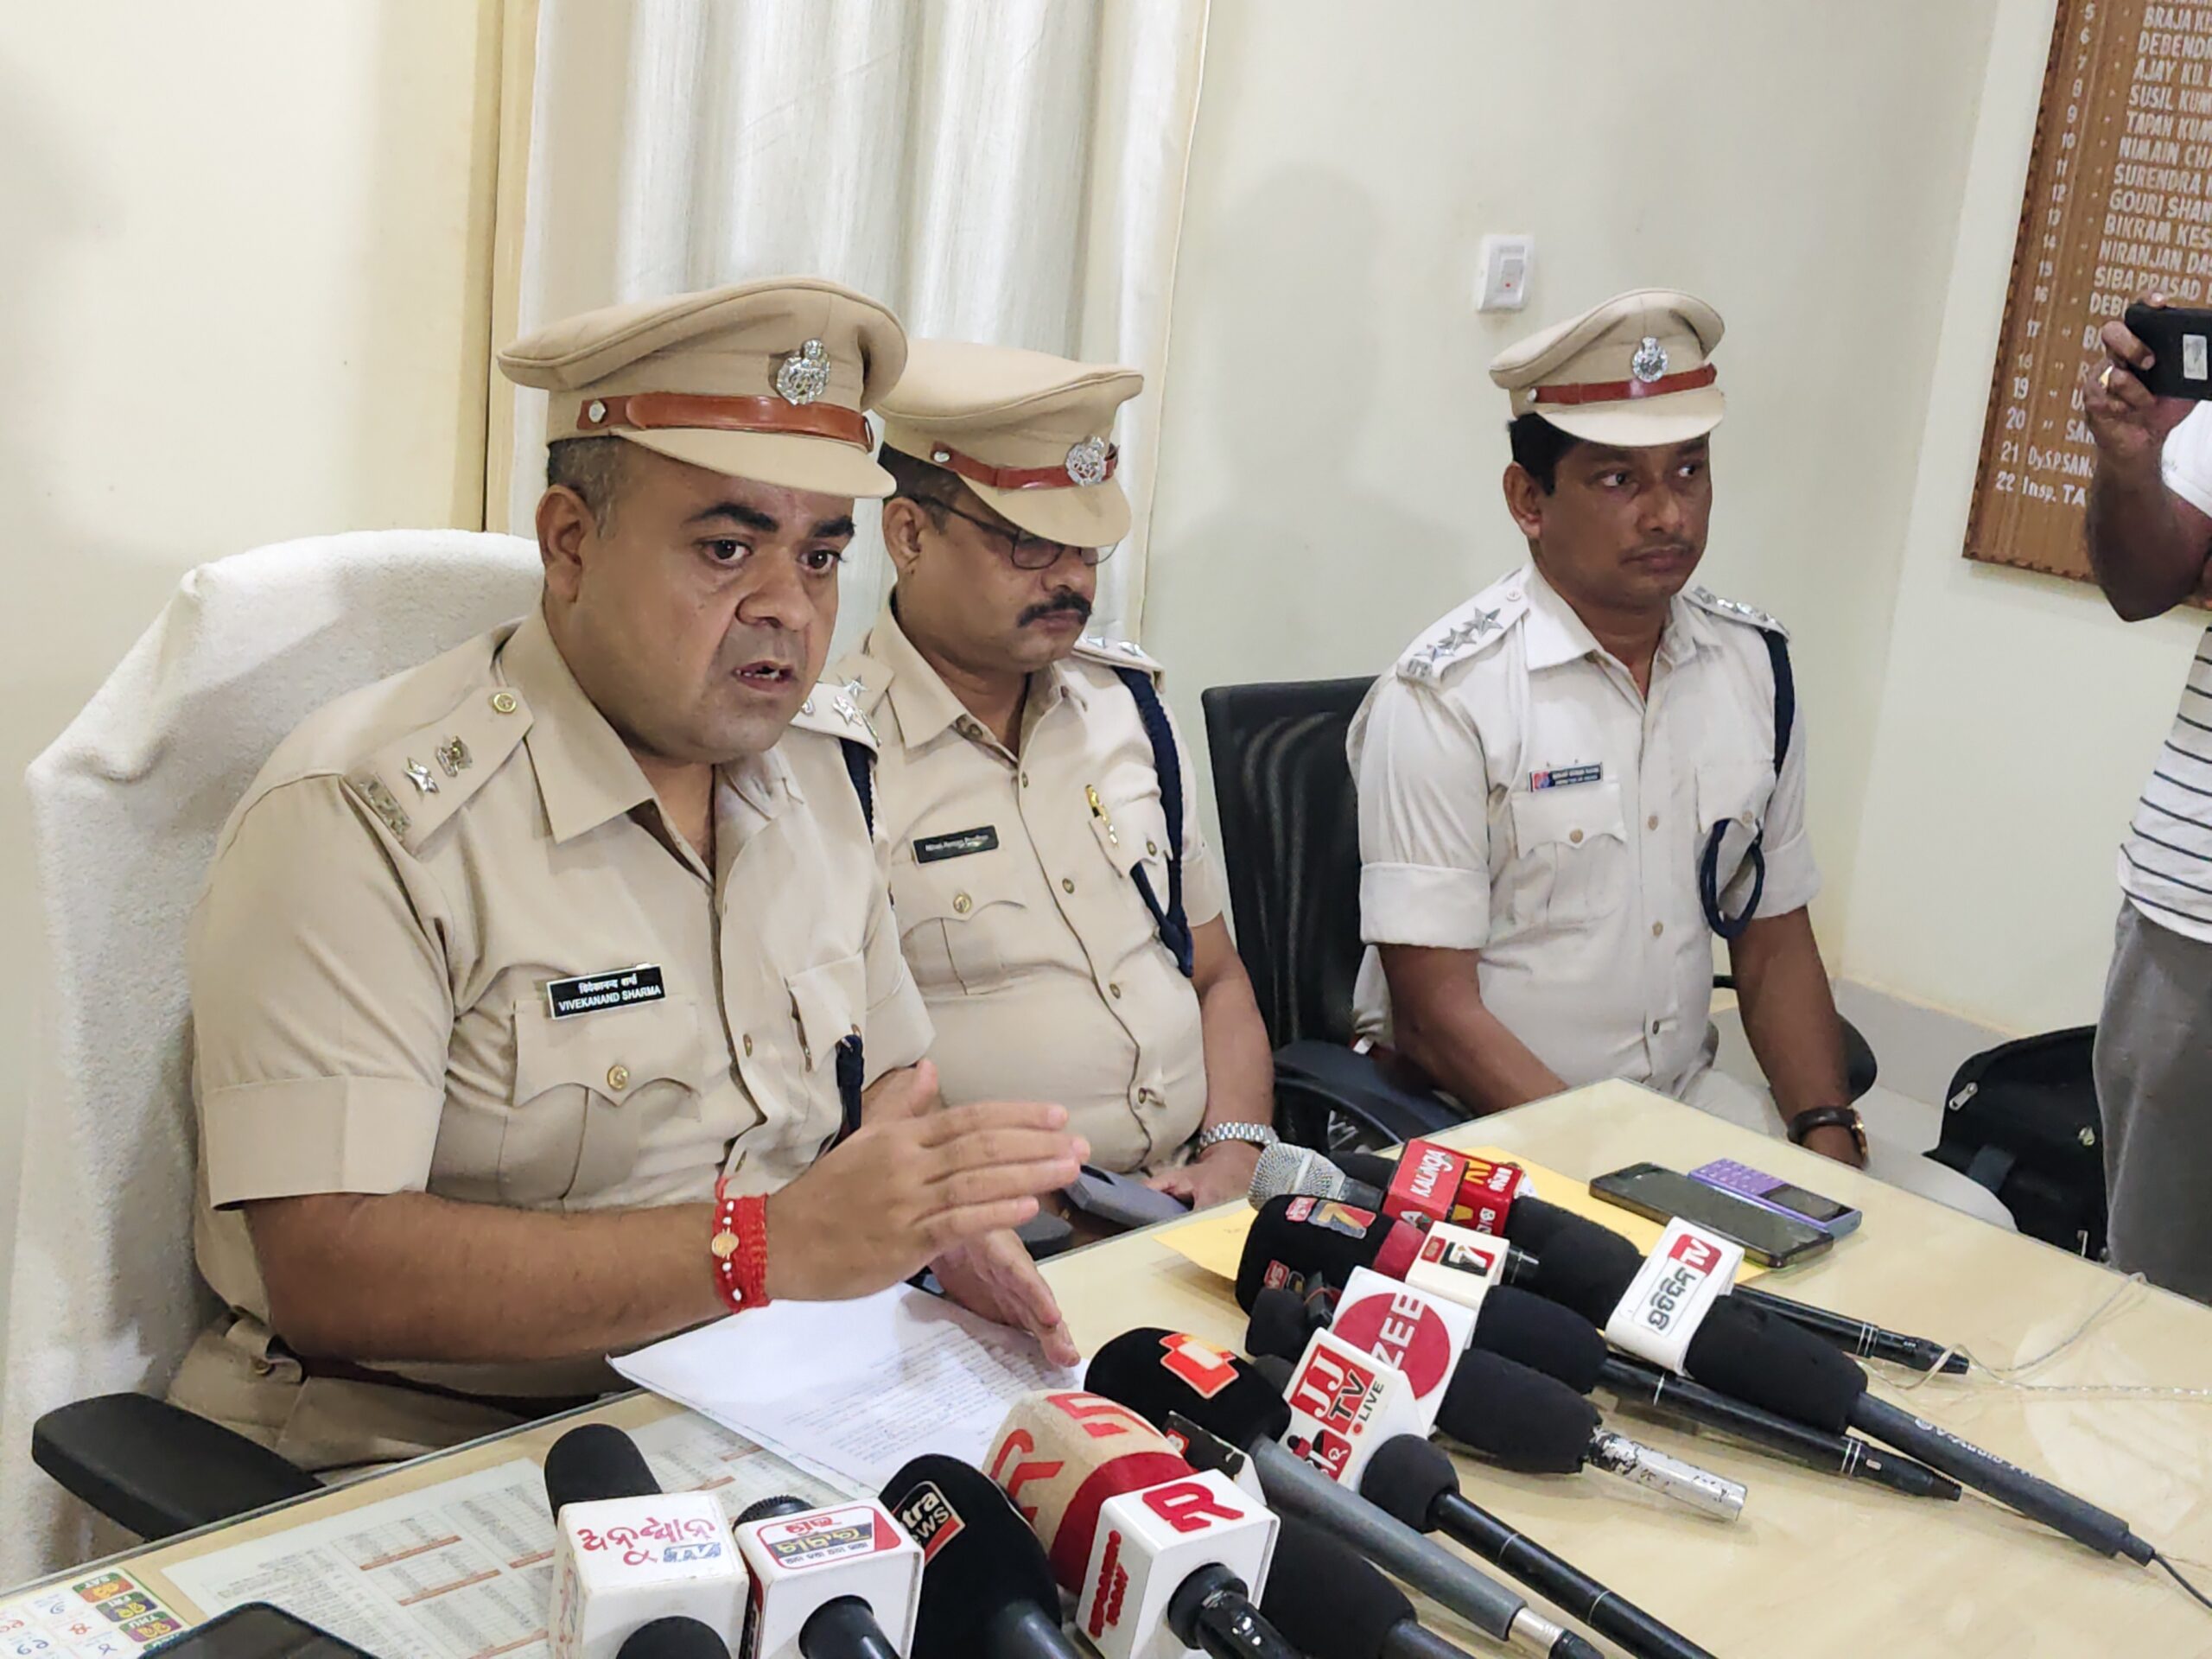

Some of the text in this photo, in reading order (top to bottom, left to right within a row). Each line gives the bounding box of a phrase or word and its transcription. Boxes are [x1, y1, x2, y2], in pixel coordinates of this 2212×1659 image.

[2084, 3, 2095, 20] 5
[2143, 5, 2191, 31] BRAJA
[2080, 26, 2089, 44] 6
[2077, 54, 2088, 71] 7
[2133, 57, 2177, 83] AJAY
[2072, 78, 2083, 98] 8
[2128, 85, 2173, 111] SUSIL
[2066, 105, 2077, 124] 9
[2126, 109, 2173, 137] TAPAN
[2062, 132, 2075, 149] 10
[2113, 162, 2202, 194] SURENDRA
[2052, 183, 2066, 202] 12
[2109, 188, 2164, 218] GOURI
[2103, 213, 2171, 244] BIKRAM
[2098, 238, 2183, 272] NIRANJAN
[2094, 264, 2134, 292] SIBA
[2026, 318, 2042, 339] 17
[2013, 376, 2029, 399] 19
[2005, 405, 2026, 430] 20
[1999, 439, 2019, 465] 21
[1995, 469, 2016, 493] 22
[558, 984, 662, 1012] VIVEKANAND SHARMA
[1679, 1236, 1712, 1267] TV
[1370, 1292, 1426, 1370] ZEE
[1296, 1350, 1344, 1419] JJ
[1326, 1369, 1366, 1421] TV
[1357, 1380, 1385, 1422] LIVE
